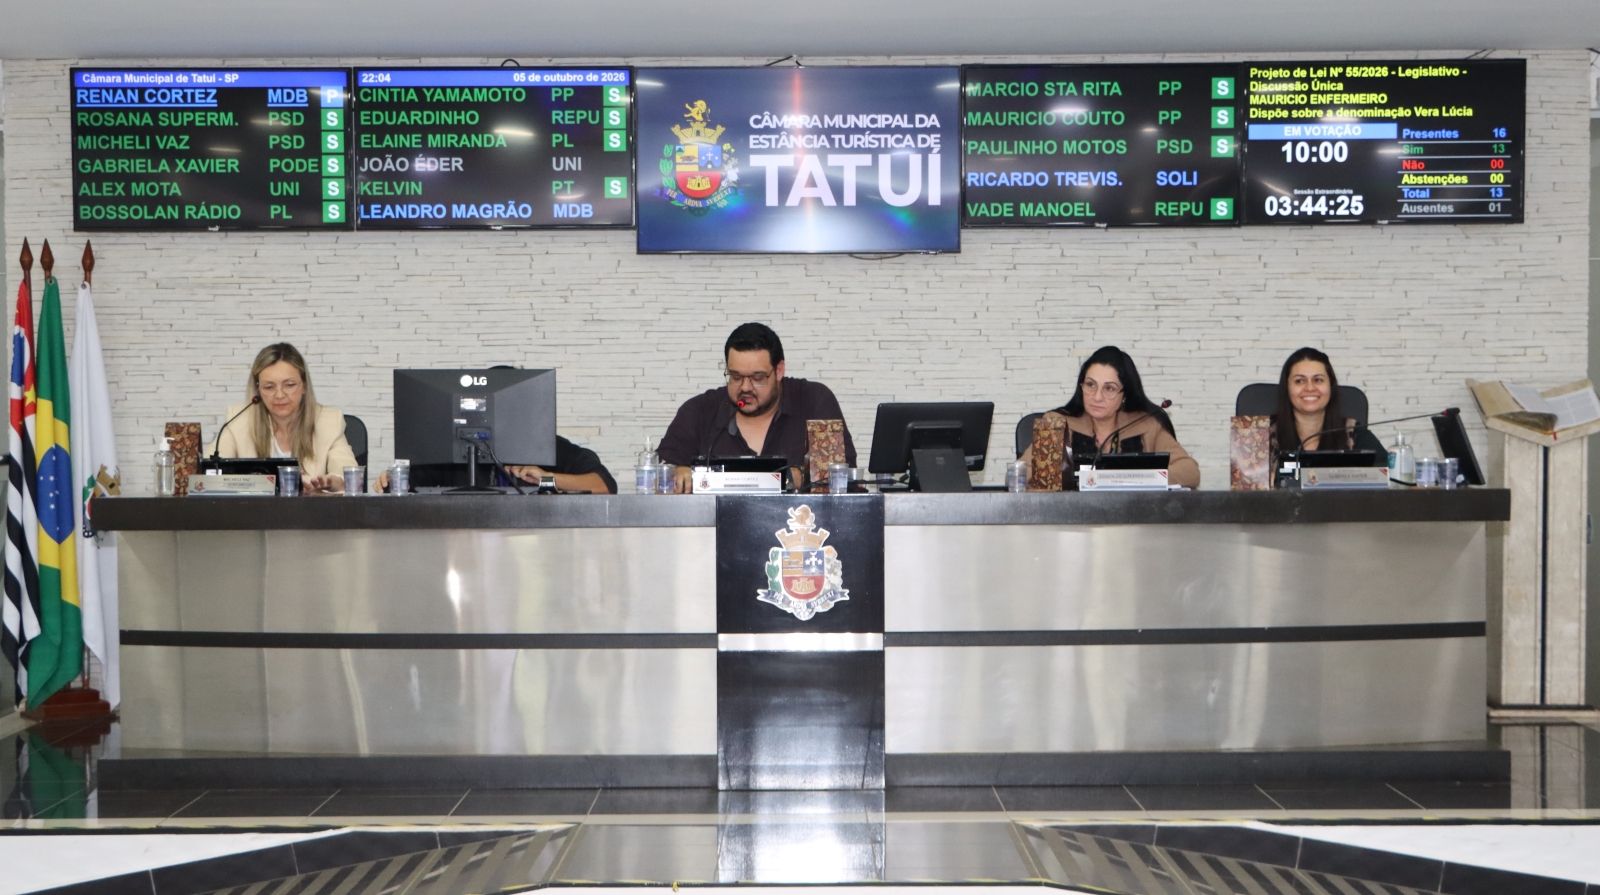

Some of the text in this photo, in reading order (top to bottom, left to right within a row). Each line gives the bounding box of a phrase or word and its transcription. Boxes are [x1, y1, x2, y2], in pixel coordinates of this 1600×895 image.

[82, 73, 121, 83] Câmara
[124, 73, 173, 84] Municipal
[176, 74, 188, 83] de
[191, 74, 216, 83] Tatuí
[224, 74, 239, 83] SP
[362, 73, 625, 83] 22:04 05 de outubro de 2026
[1250, 69, 1290, 80] Projeto
[1293, 69, 1306, 78] de
[1310, 68, 1326, 77] Lei
[1330, 68, 1342, 77] Nº
[1346, 68, 1388, 77] 55/2026
[1399, 67, 1459, 79] Legislativo
[967, 81, 1229, 96] MARCIO STA RITA PP S
[1250, 80, 1343, 91] Discussão Única
[76, 89, 338, 104] RENAN CORTEZ MDB P
[360, 88, 620, 102] CINTIA YAMAMOTO PP S
[1250, 94, 1387, 105] MAURICIO ENFERMEIRO
[77, 112, 338, 126] ROSANA SUPERM. PSD S
[360, 110, 620, 126] EDUARDINHO REPU S
[749, 112, 940, 128] CÂMARA MUNICIPAL DA
[967, 110, 1228, 126] MAURICIO COUTO PP S
[1250, 107, 1473, 120] Dispõe sobre a denominação Vera Lúcia
[1284, 124, 1361, 138] EM VOTAÇÃO
[1402, 128, 1506, 138] Presentes 16
[78, 135, 339, 149] MICHELI VAZ PSD S
[360, 133, 620, 148] ELAINE MIRANDA PL S
[749, 131, 940, 148] ESTÂNCIA TURÍSTICA DE
[968, 139, 1228, 154] PAULINHO MOTOS PSD S
[1282, 142, 1348, 162] 10:00
[1402, 144, 1505, 154] Sim 13
[78, 158, 339, 173] GABRIELA XAVIER PODE S
[360, 154, 582, 172] JOÃO ÉDER UNI
[1402, 160, 1504, 169] Não 00
[750, 146, 941, 207] TATUÍ
[968, 171, 1197, 186] RICARDO TREVIS. SOLI
[1402, 174, 1504, 186] Abstenções 00
[79, 181, 339, 196] ALEX MOTA UNI S
[360, 180, 621, 195] KELVIN PT S
[1402, 188, 1503, 198] Total 13
[80, 202, 340, 219] BOSSOLAN RÁDIO PL S
[360, 201, 593, 219] LEANDRO MAGRÃO MDB
[967, 201, 1228, 217] VADE MANOEL REPU S
[1265, 196, 1363, 216] 03:44:25
[1402, 203, 1501, 213] Ausentes 01
[474, 377, 487, 385] LG
